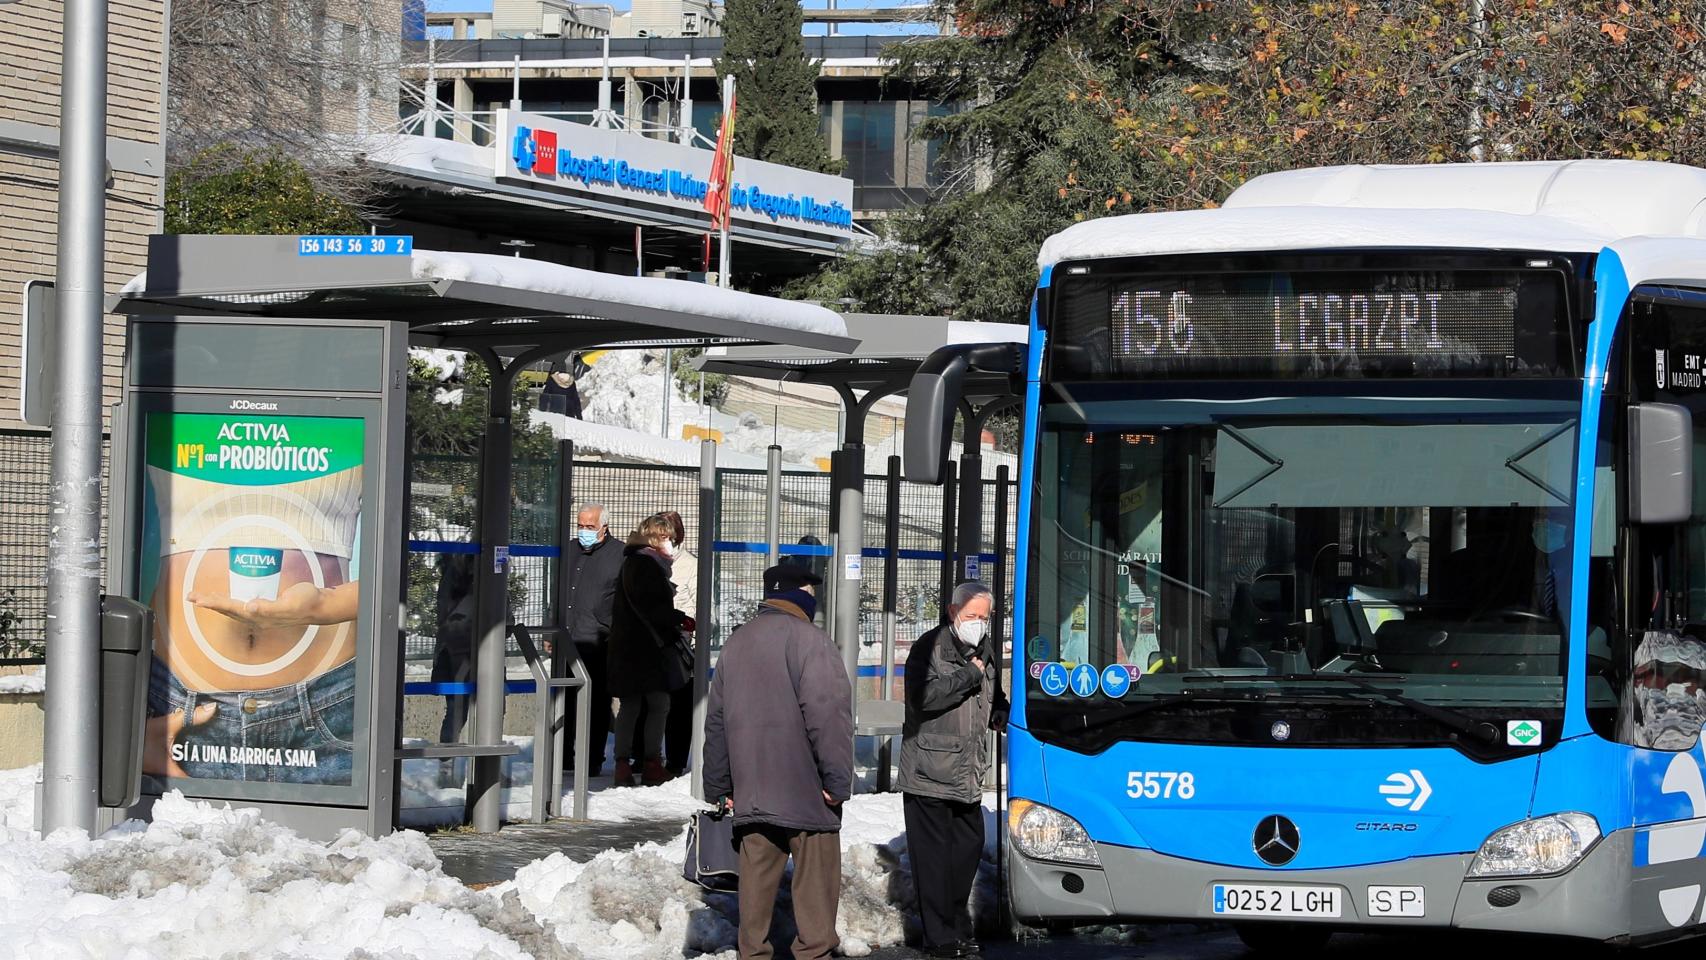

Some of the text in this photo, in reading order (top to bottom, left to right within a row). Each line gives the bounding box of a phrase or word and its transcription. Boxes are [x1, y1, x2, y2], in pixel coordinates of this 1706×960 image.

[558, 149, 615, 184] Hospital
[616, 160, 669, 193] General
[748, 186, 800, 218] Gregorio
[801, 196, 852, 226] Marañón
[301, 239, 405, 252] 156 143 56 30 2
[1112, 290, 1443, 355] 156 LEGAZPI
[1684, 354, 1701, 370] EMT
[1672, 371, 1701, 388] MADRID
[229, 399, 278, 411] JCDecaux
[217, 422, 290, 442] ACTIVIA
[205, 452, 218, 463] con
[233, 553, 276, 566] ACTIVIA
[1033, 664, 1041, 676] 2
[1130, 667, 1138, 678] 4
[1514, 728, 1536, 738] GNC
[171, 741, 317, 768] SÍ A UNA BARRIGA SANA
[1126, 771, 1195, 799] 5578
[1355, 822, 1418, 832] CITARO
[1227, 889, 1282, 912] 0252
[1290, 890, 1334, 913] LGH
